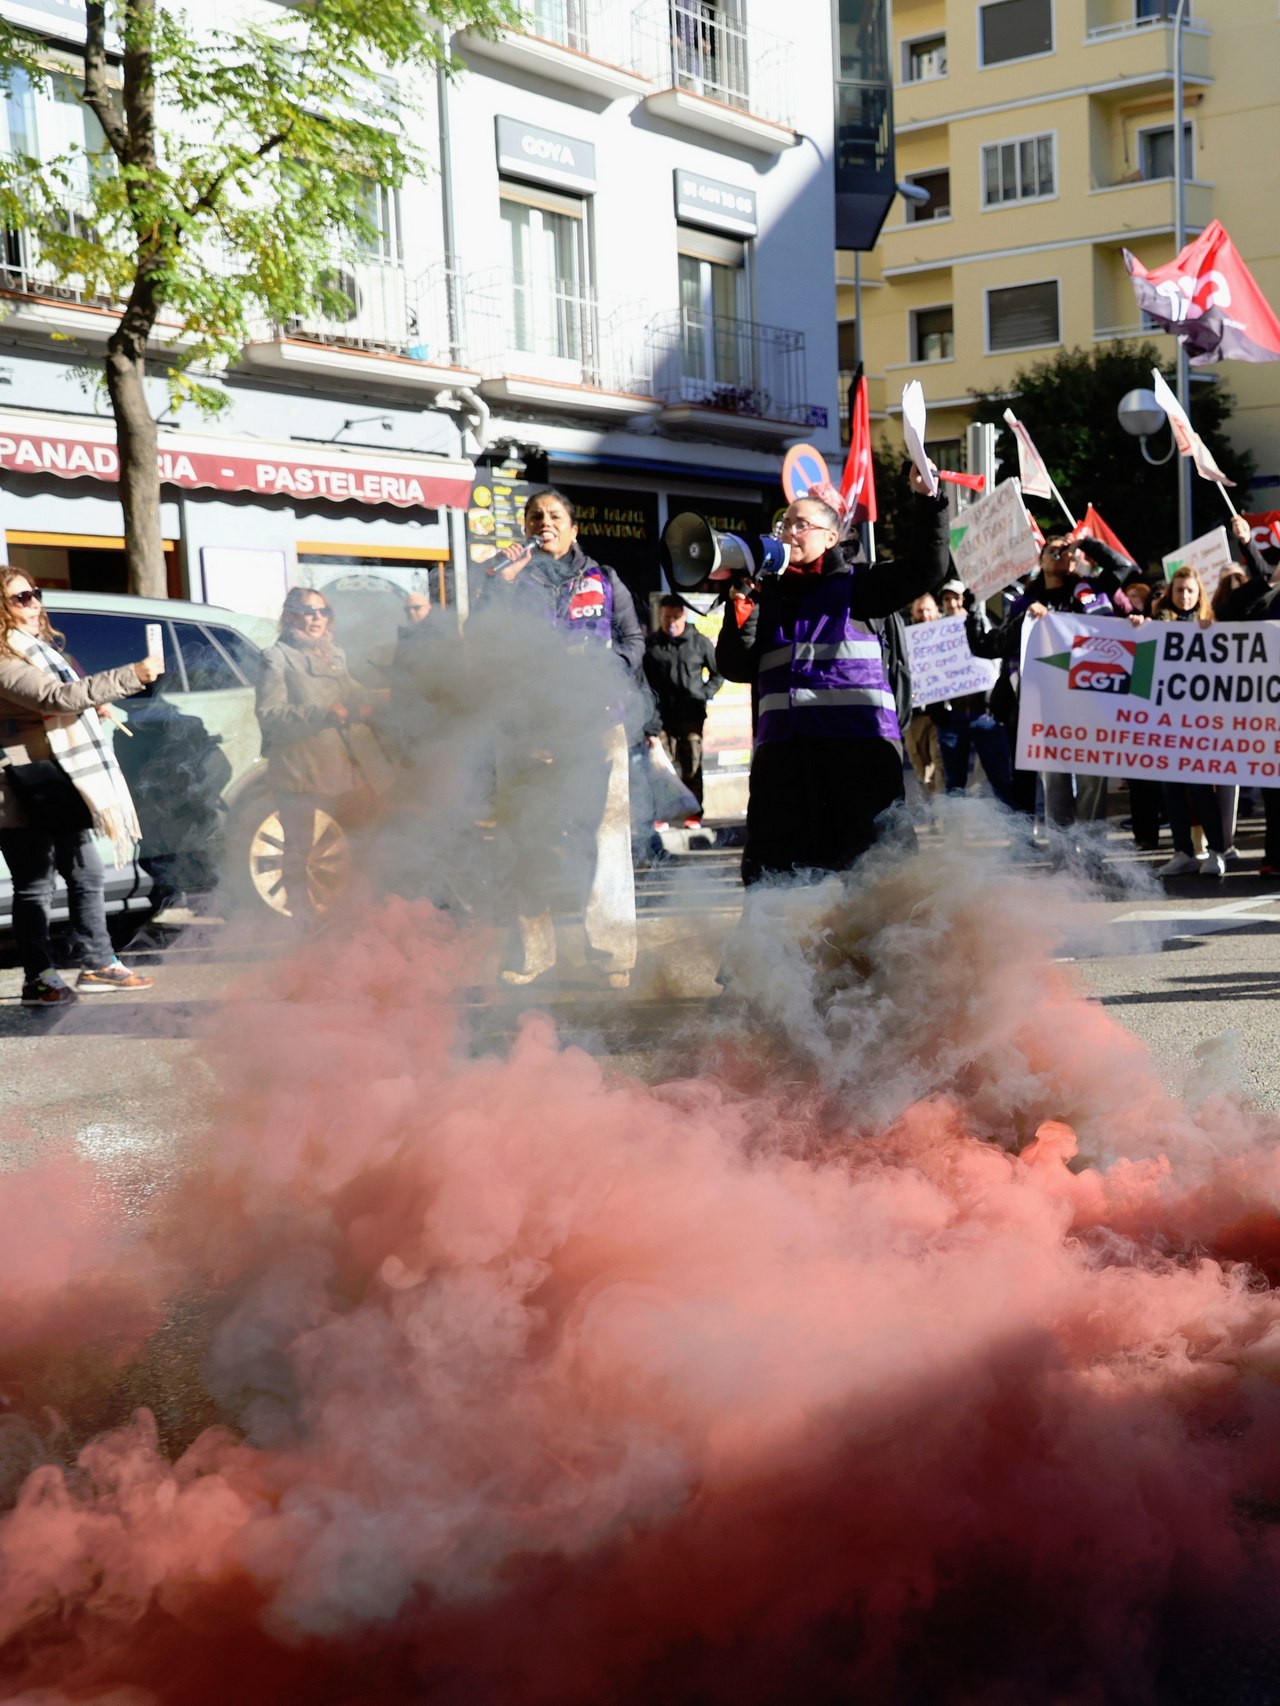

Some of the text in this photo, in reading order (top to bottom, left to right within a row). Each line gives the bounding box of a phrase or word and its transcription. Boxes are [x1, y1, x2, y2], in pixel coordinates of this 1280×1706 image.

[520, 135, 576, 167] GOYA
[0, 437, 198, 481] PANADIA
[256, 464, 425, 502] PASTELERIA
[572, 604, 604, 618] CGT
[1163, 631, 1267, 663] BASTA
[1074, 670, 1126, 693] CGT
[1116, 708, 1149, 725] NO
[1158, 712, 1172, 727] A
[1181, 714, 1224, 730] LOS
[1031, 723, 1088, 741] PAGO
[1096, 727, 1267, 755] DIFERENCIADO
[1178, 758, 1237, 774] PARA
